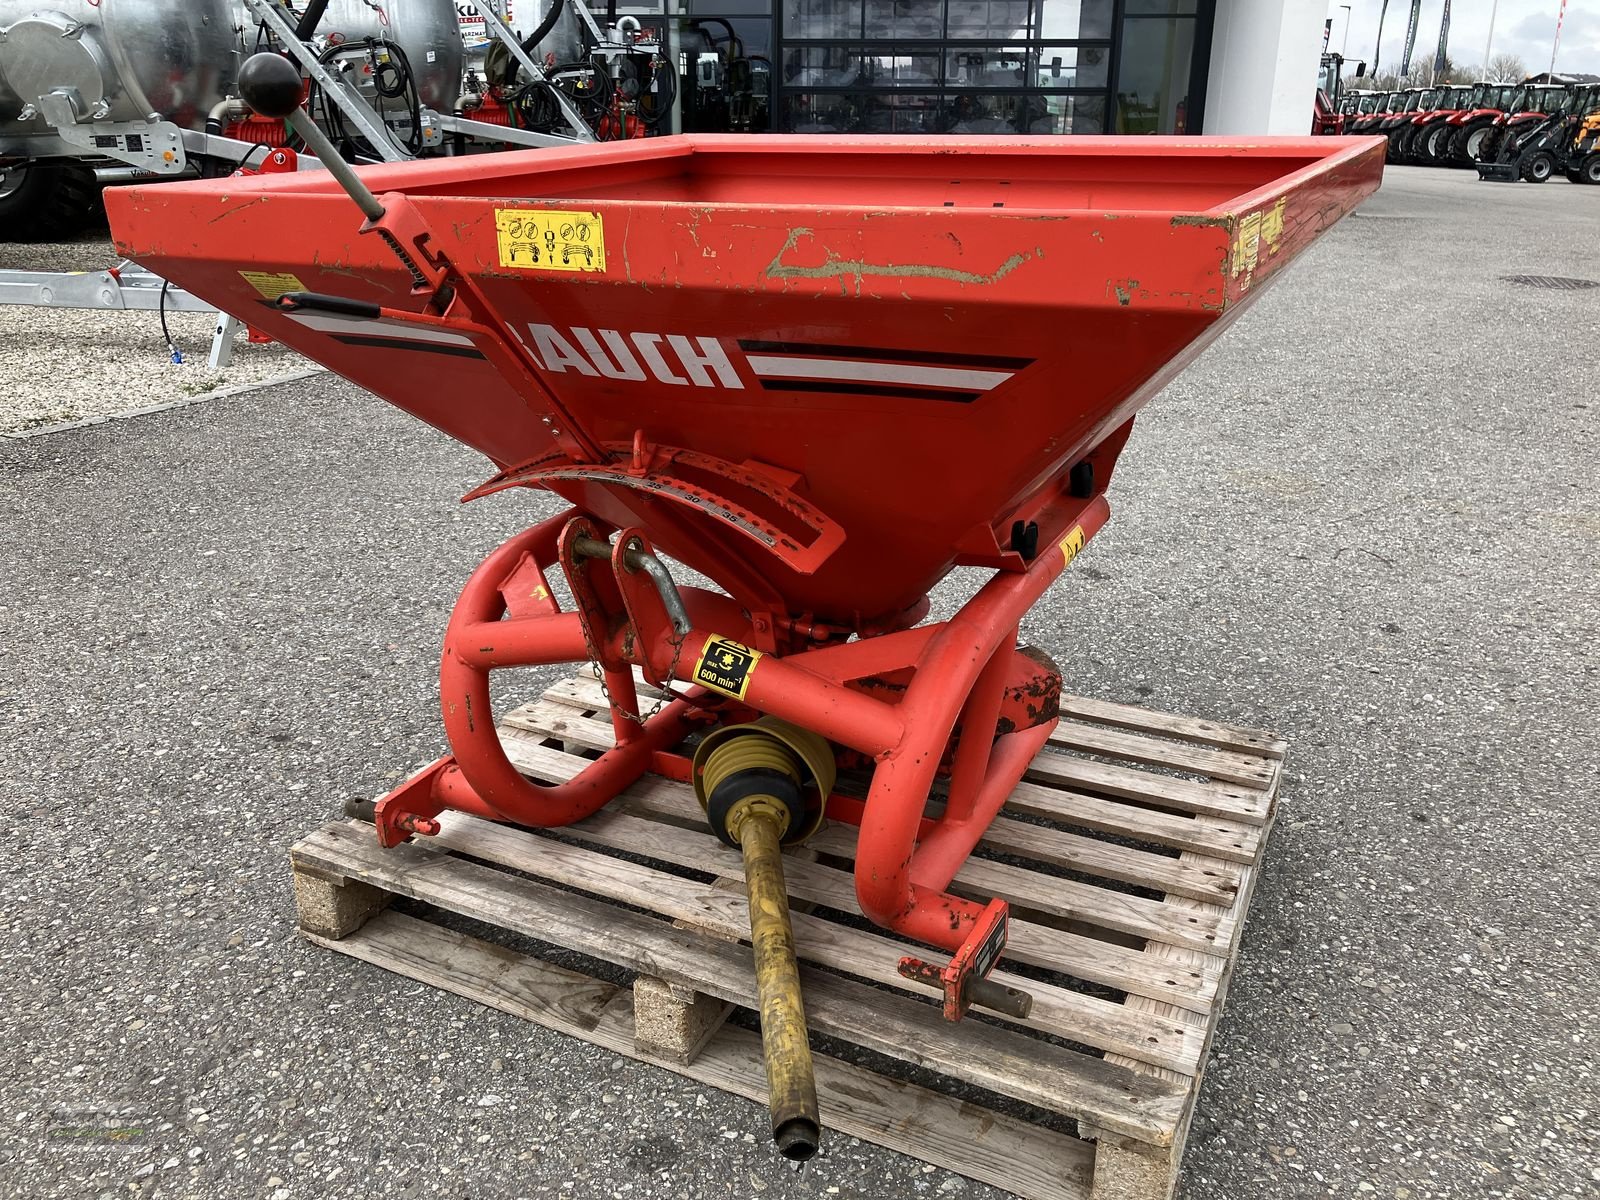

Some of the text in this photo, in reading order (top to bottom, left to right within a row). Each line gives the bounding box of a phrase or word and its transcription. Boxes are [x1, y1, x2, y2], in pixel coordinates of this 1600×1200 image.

[647, 481, 663, 490] 25
[684, 493, 701, 503] 30
[722, 511, 738, 522] 35
[700, 668, 717, 682] 600
